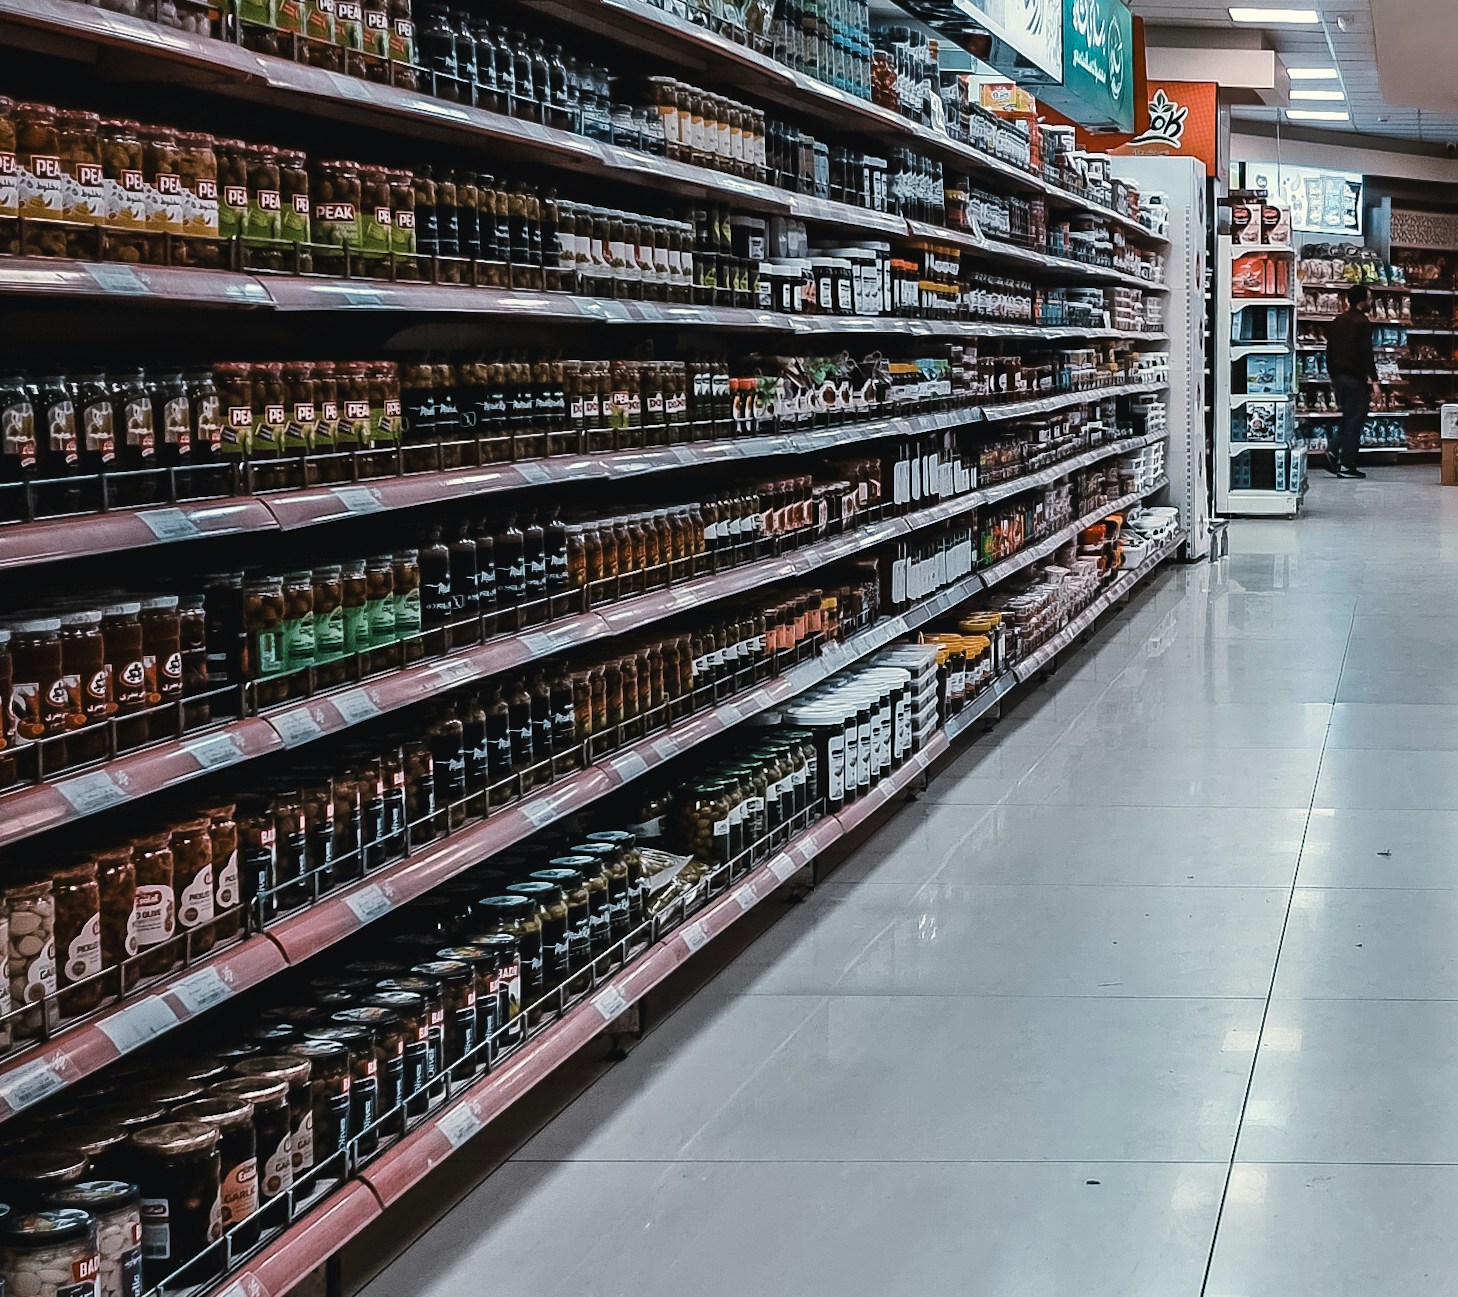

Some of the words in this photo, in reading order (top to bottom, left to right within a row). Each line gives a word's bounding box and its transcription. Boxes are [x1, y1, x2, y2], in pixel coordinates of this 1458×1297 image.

[36, 159, 61, 177] PEA
[81, 167, 103, 185] PEA
[160, 176, 181, 193] PEA
[315, 205, 354, 220] PEAK
[79, 1258, 101, 1278] BAD
